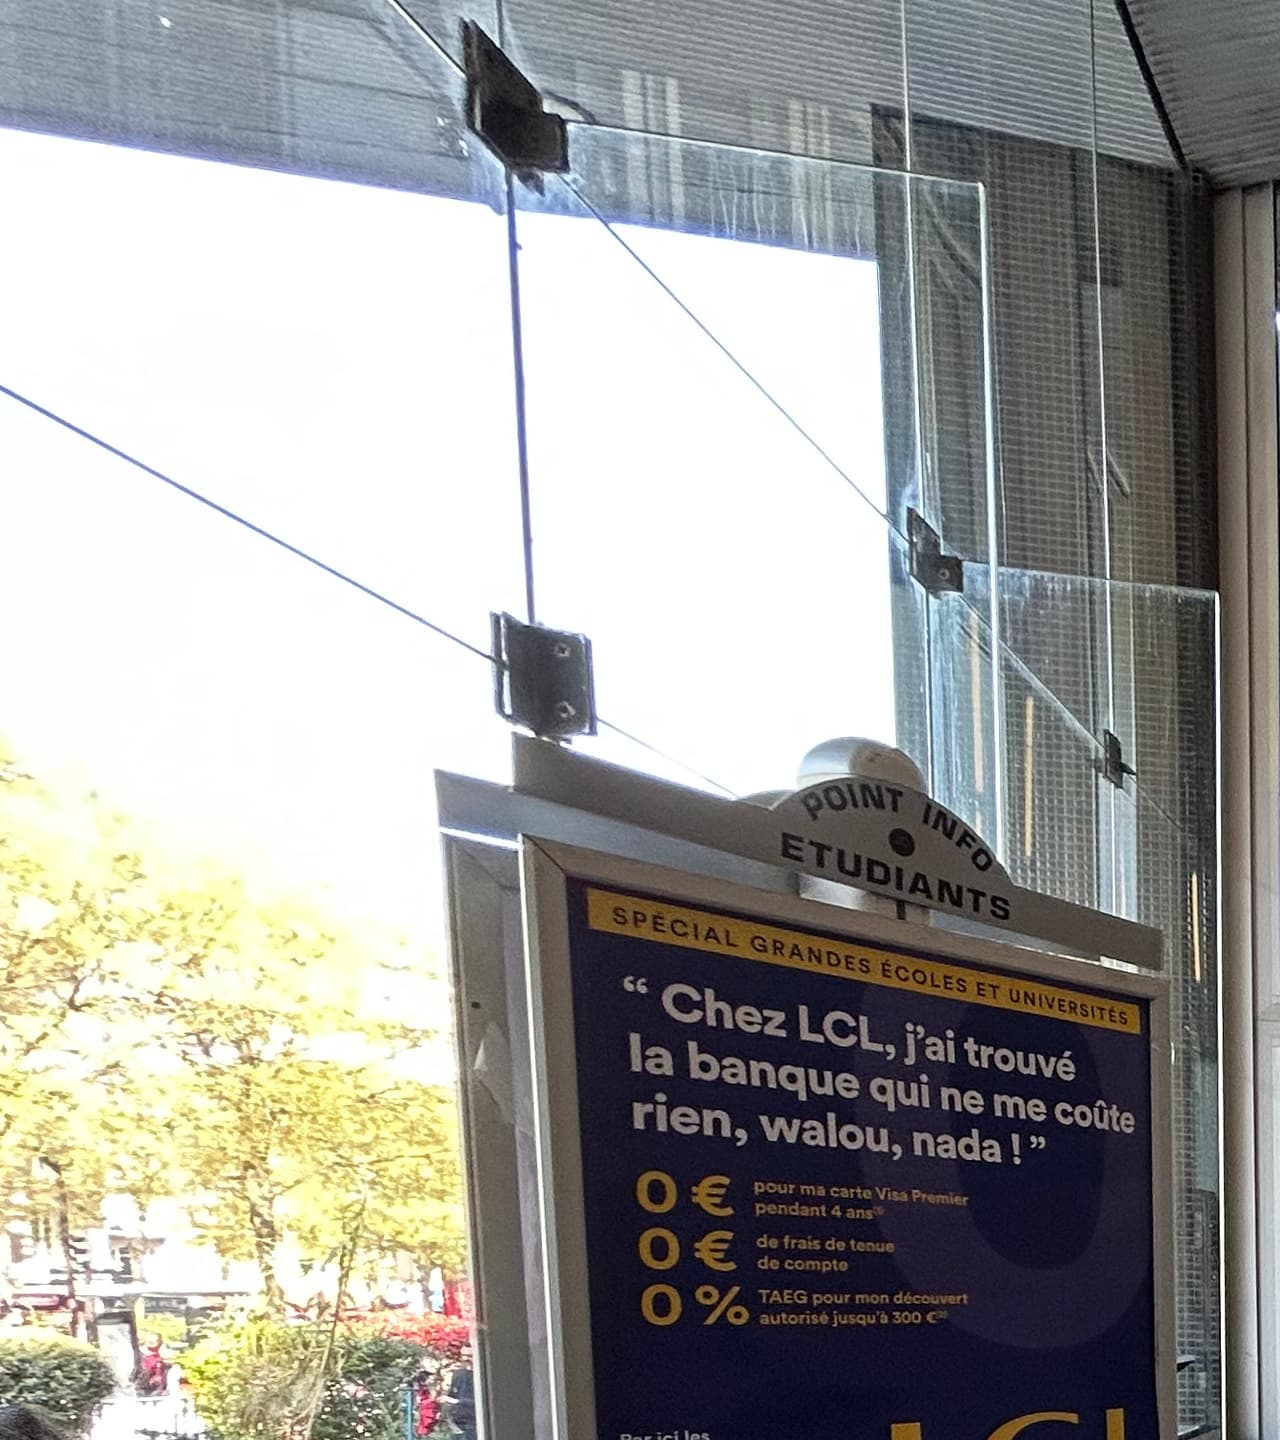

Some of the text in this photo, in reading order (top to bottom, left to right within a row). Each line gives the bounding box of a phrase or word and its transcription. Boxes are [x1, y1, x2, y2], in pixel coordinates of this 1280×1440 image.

[804, 783, 993, 872] POINT INFO
[781, 832, 1010, 920] ETUDIANTS
[613, 906, 1129, 1026] SPÉCIAL GRANDES ÉCOLES ET UNIVERSITÉS
[661, 982, 786, 1038] Chez
[798, 1005, 897, 1061] LCL,
[904, 1021, 956, 1066] j’ai
[964, 1037, 1077, 1081] trouvé
[629, 1034, 1136, 1134] la banque qui ne me coûte
[631, 1094, 749, 1148] rien,
[761, 1112, 903, 1161] walou,
[912, 1127, 1003, 1164] nada
[635, 1170, 735, 1217] 0 €
[753, 1181, 969, 1206] pour ma carte Visa Premier
[754, 1202, 827, 1217] pendant
[831, 1205, 842, 1217] 4
[638, 1227, 738, 1272] 0 €
[756, 1234, 896, 1253] de frais de tenue
[757, 1256, 849, 1273] de compte
[640, 1284, 750, 1326] 0 %
[758, 1289, 969, 1307] TAEG pour mon découvert
[759, 1311, 829, 1325] autorisé
[892, 1311, 921, 1324] 300
